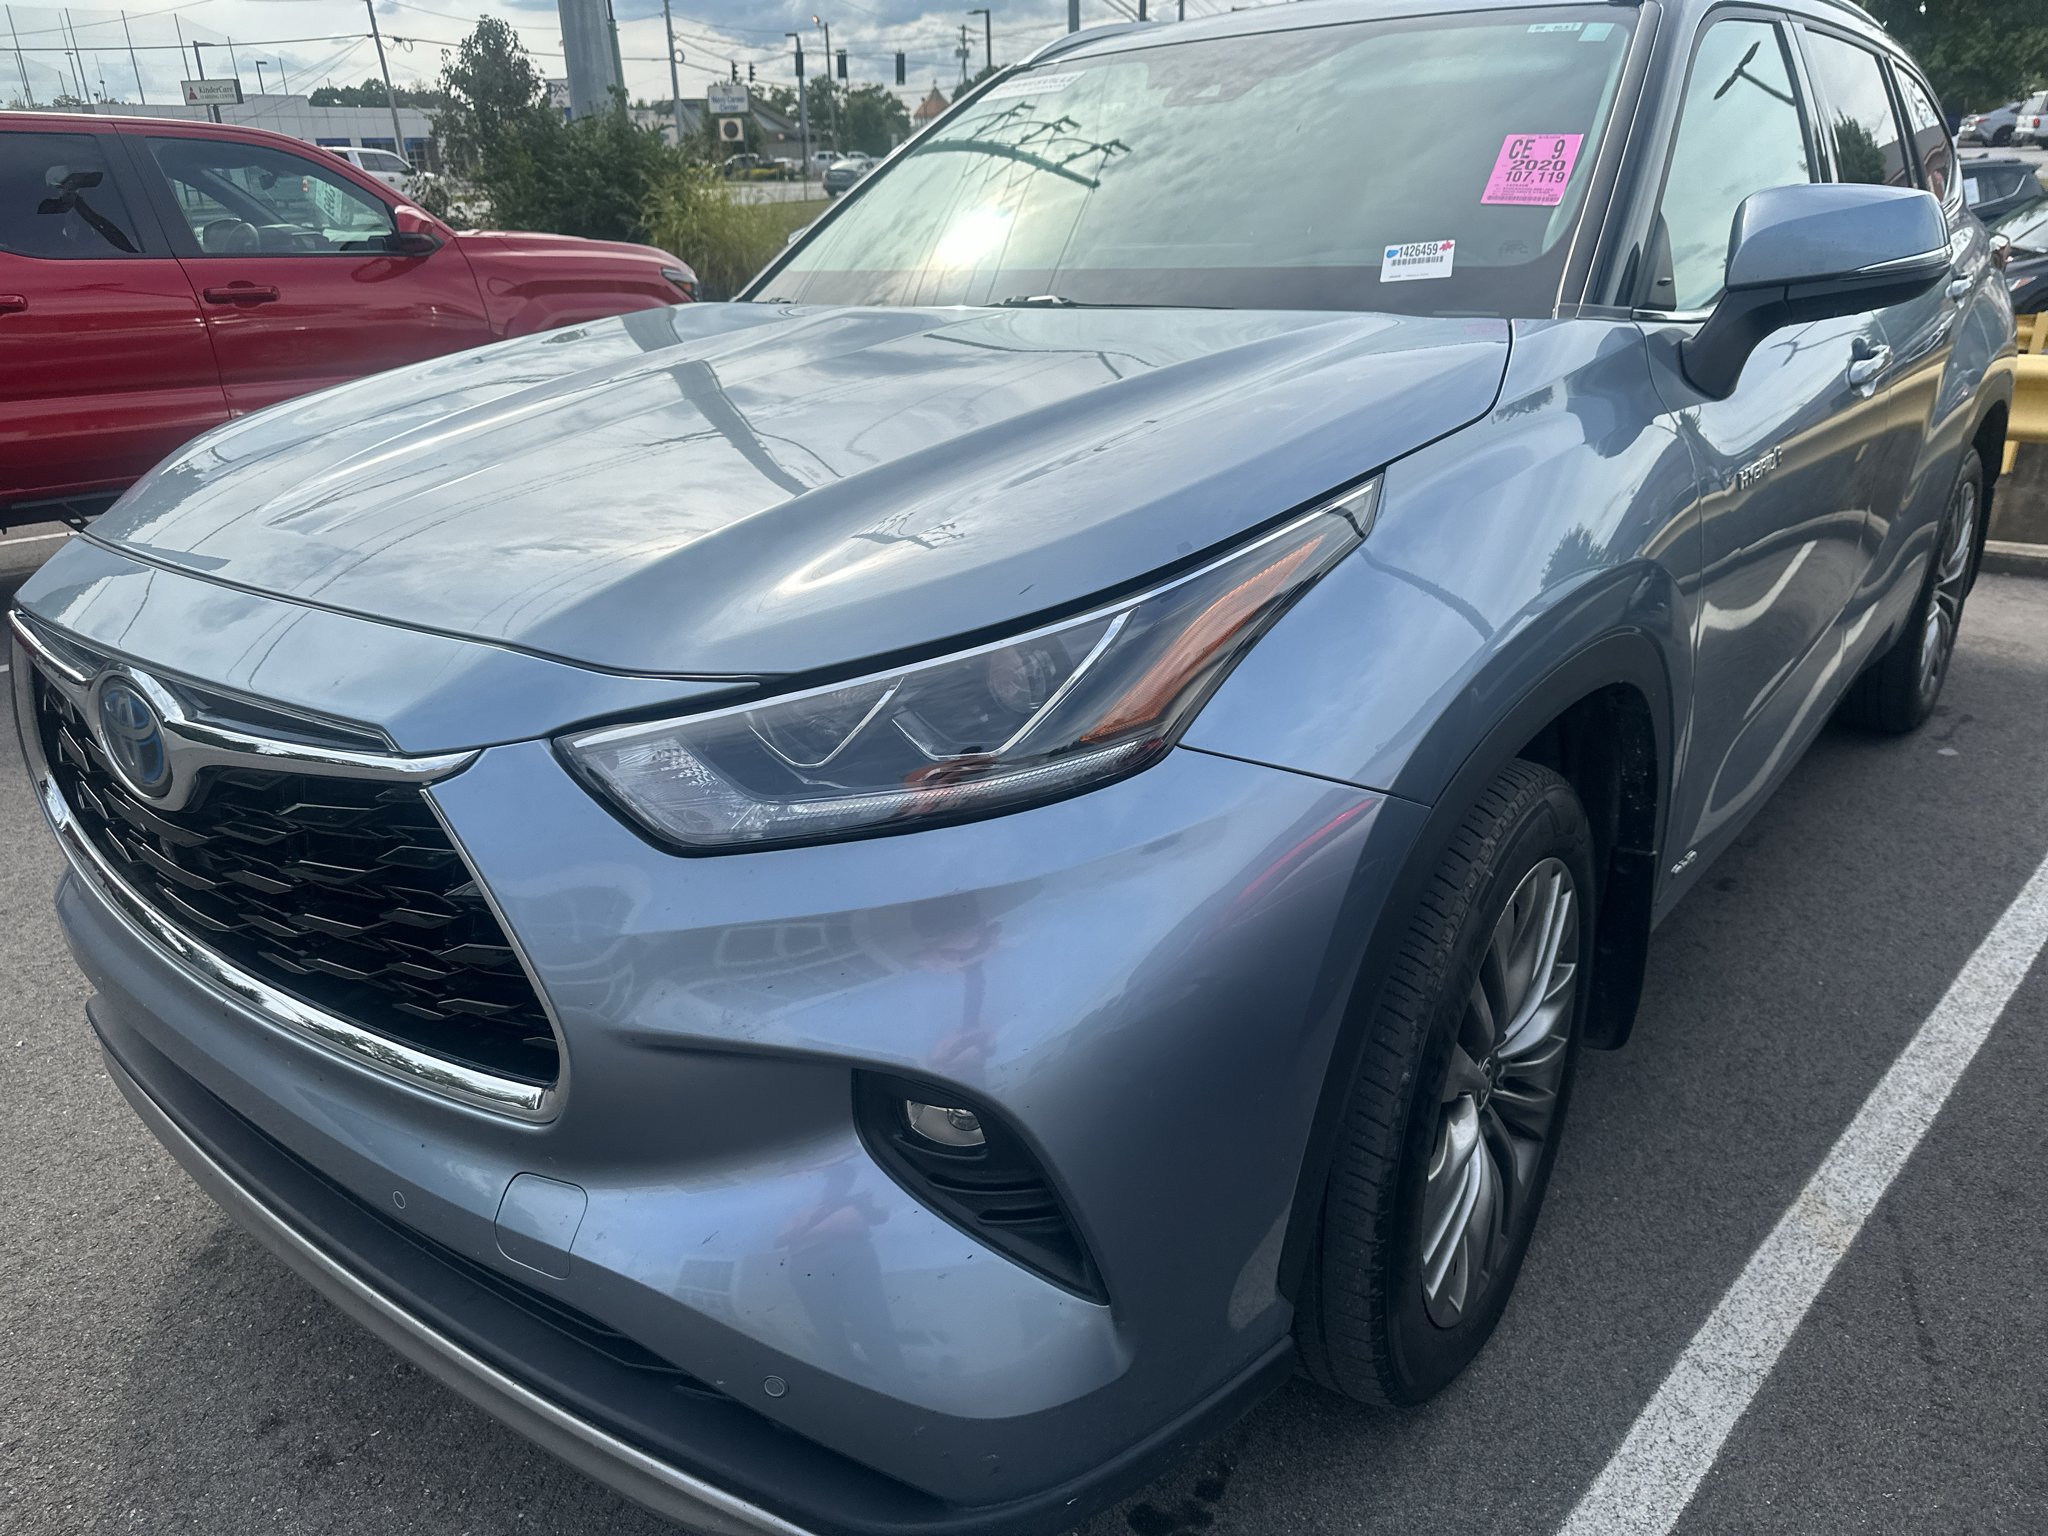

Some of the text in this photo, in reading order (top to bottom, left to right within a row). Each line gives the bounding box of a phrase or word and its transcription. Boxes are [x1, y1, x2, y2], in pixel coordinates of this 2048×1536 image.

[1509, 139, 1565, 159] CE 9
[1510, 160, 1566, 171] 2020
[1505, 171, 1565, 184] 107,119
[1399, 243, 1438, 258] 1426459
